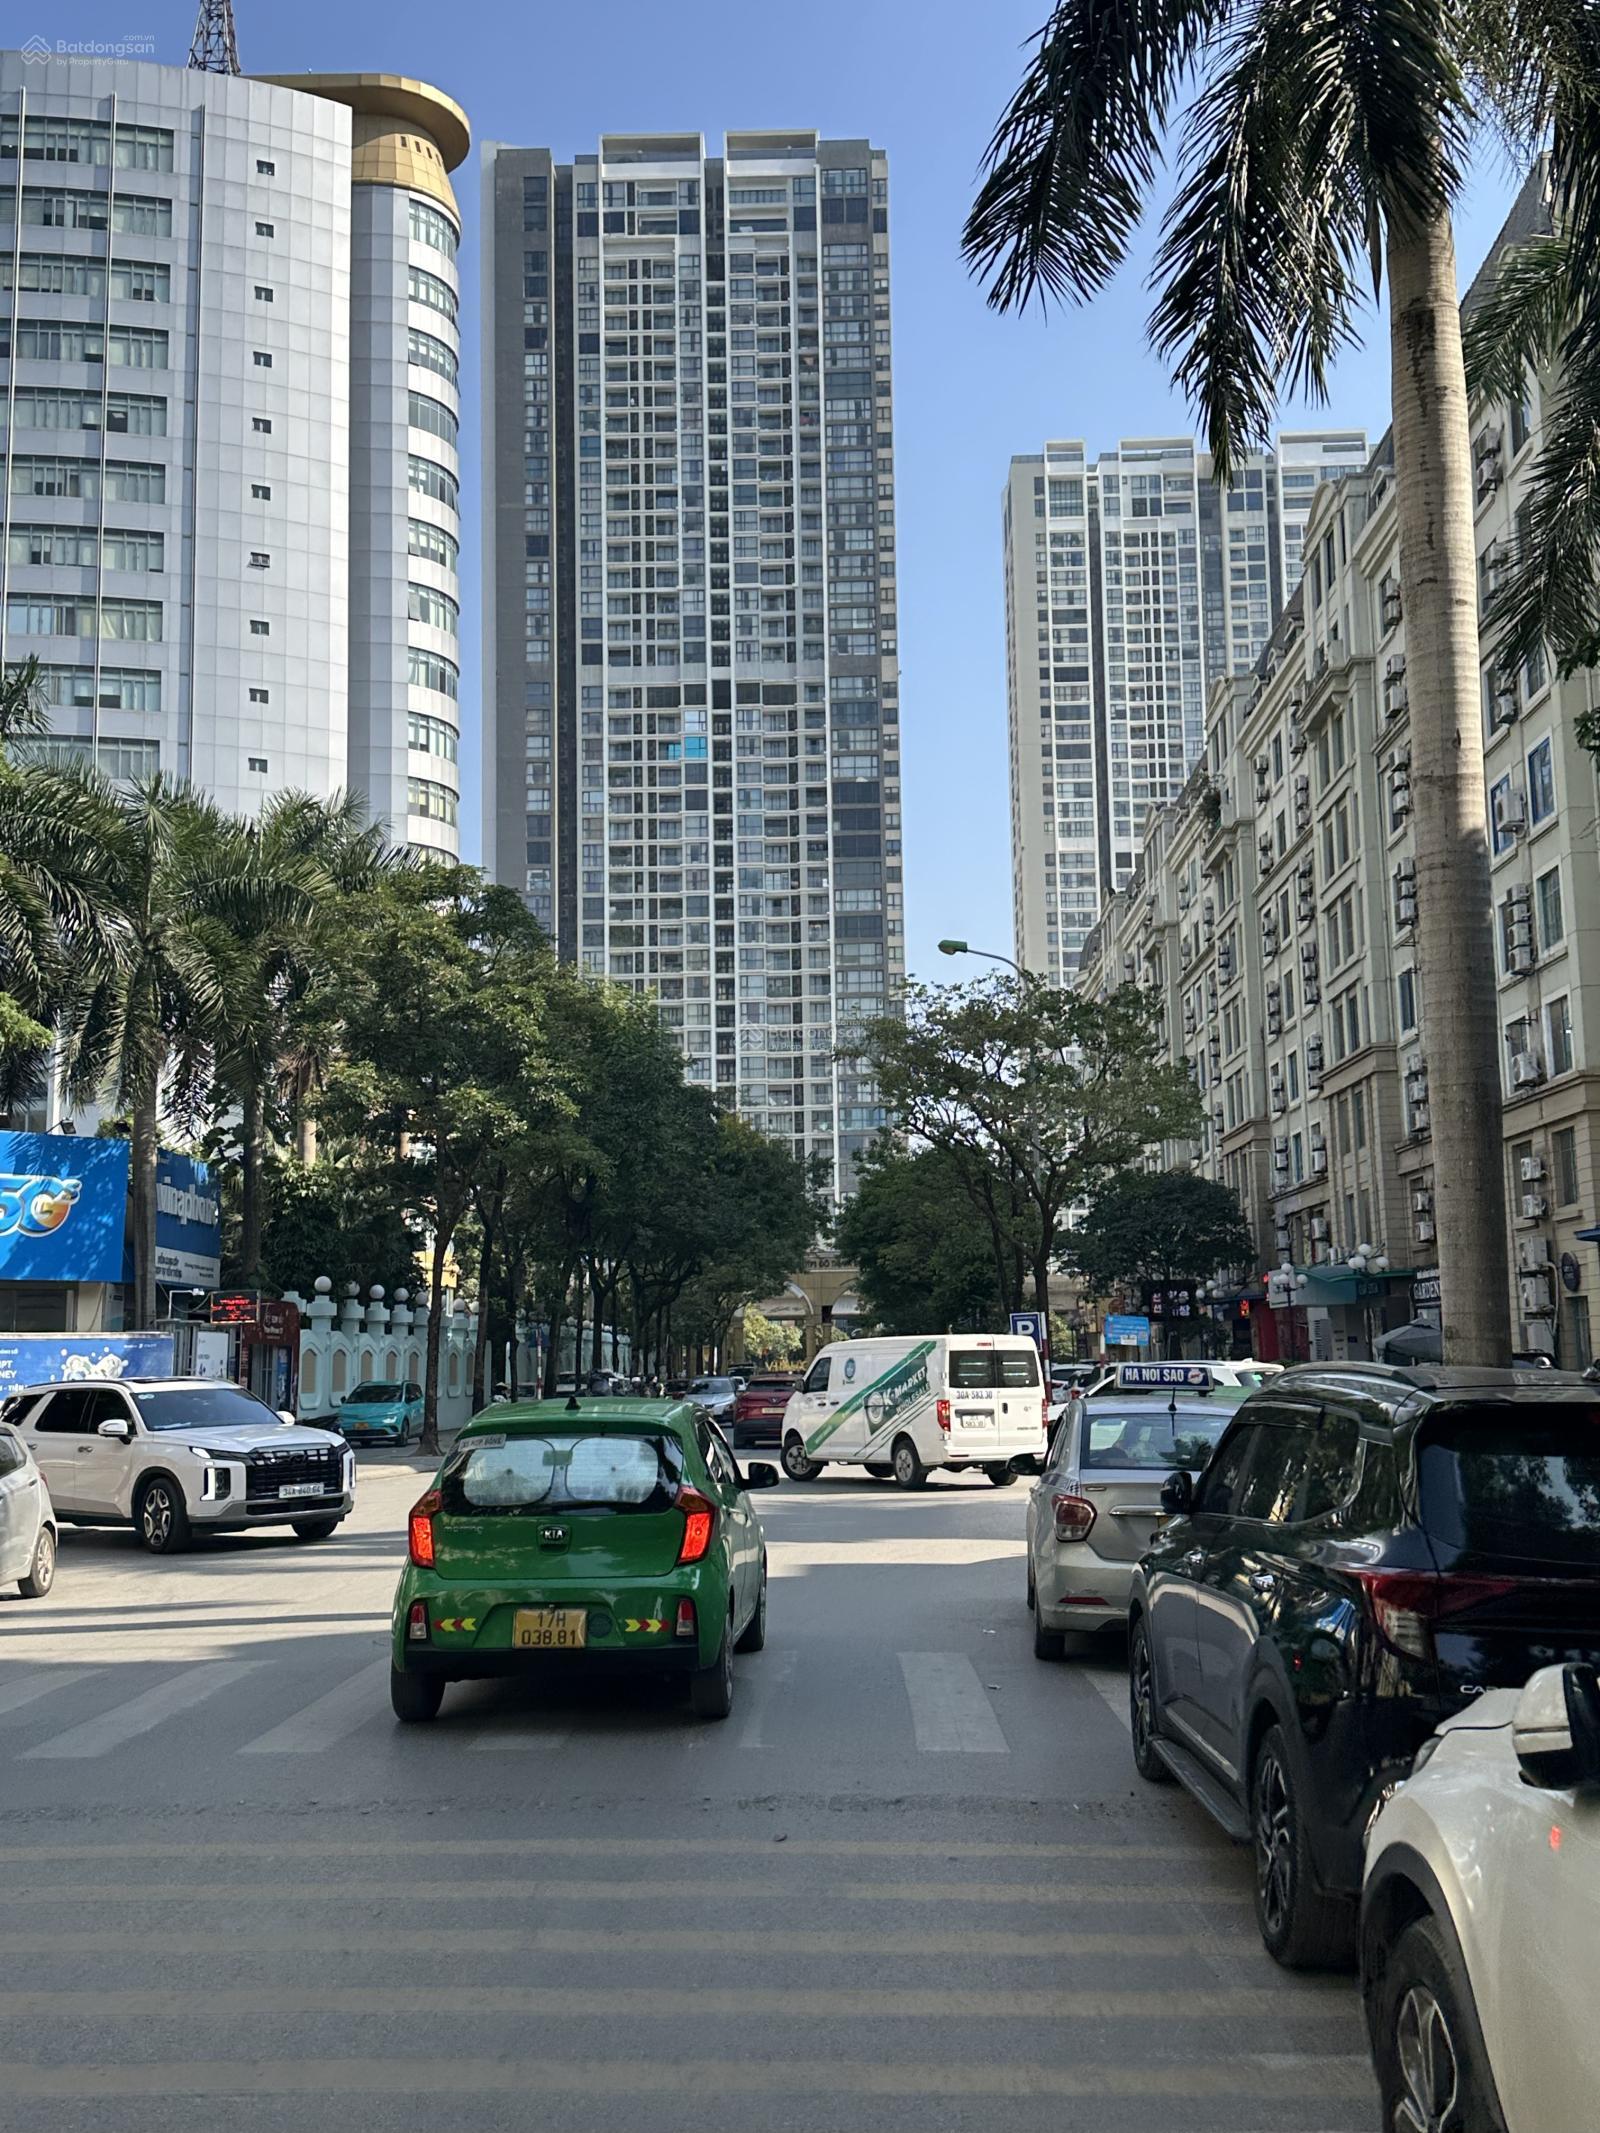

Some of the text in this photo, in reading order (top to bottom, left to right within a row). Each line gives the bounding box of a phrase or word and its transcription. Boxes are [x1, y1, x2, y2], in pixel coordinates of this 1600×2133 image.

[0, 1173, 73, 1238] 5G
[1017, 1321, 1035, 1335] P
[1125, 1367, 1185, 1382] HA NOI SAO
[544, 1529, 563, 1539] KIA
[521, 1629, 577, 1646] 038.81
